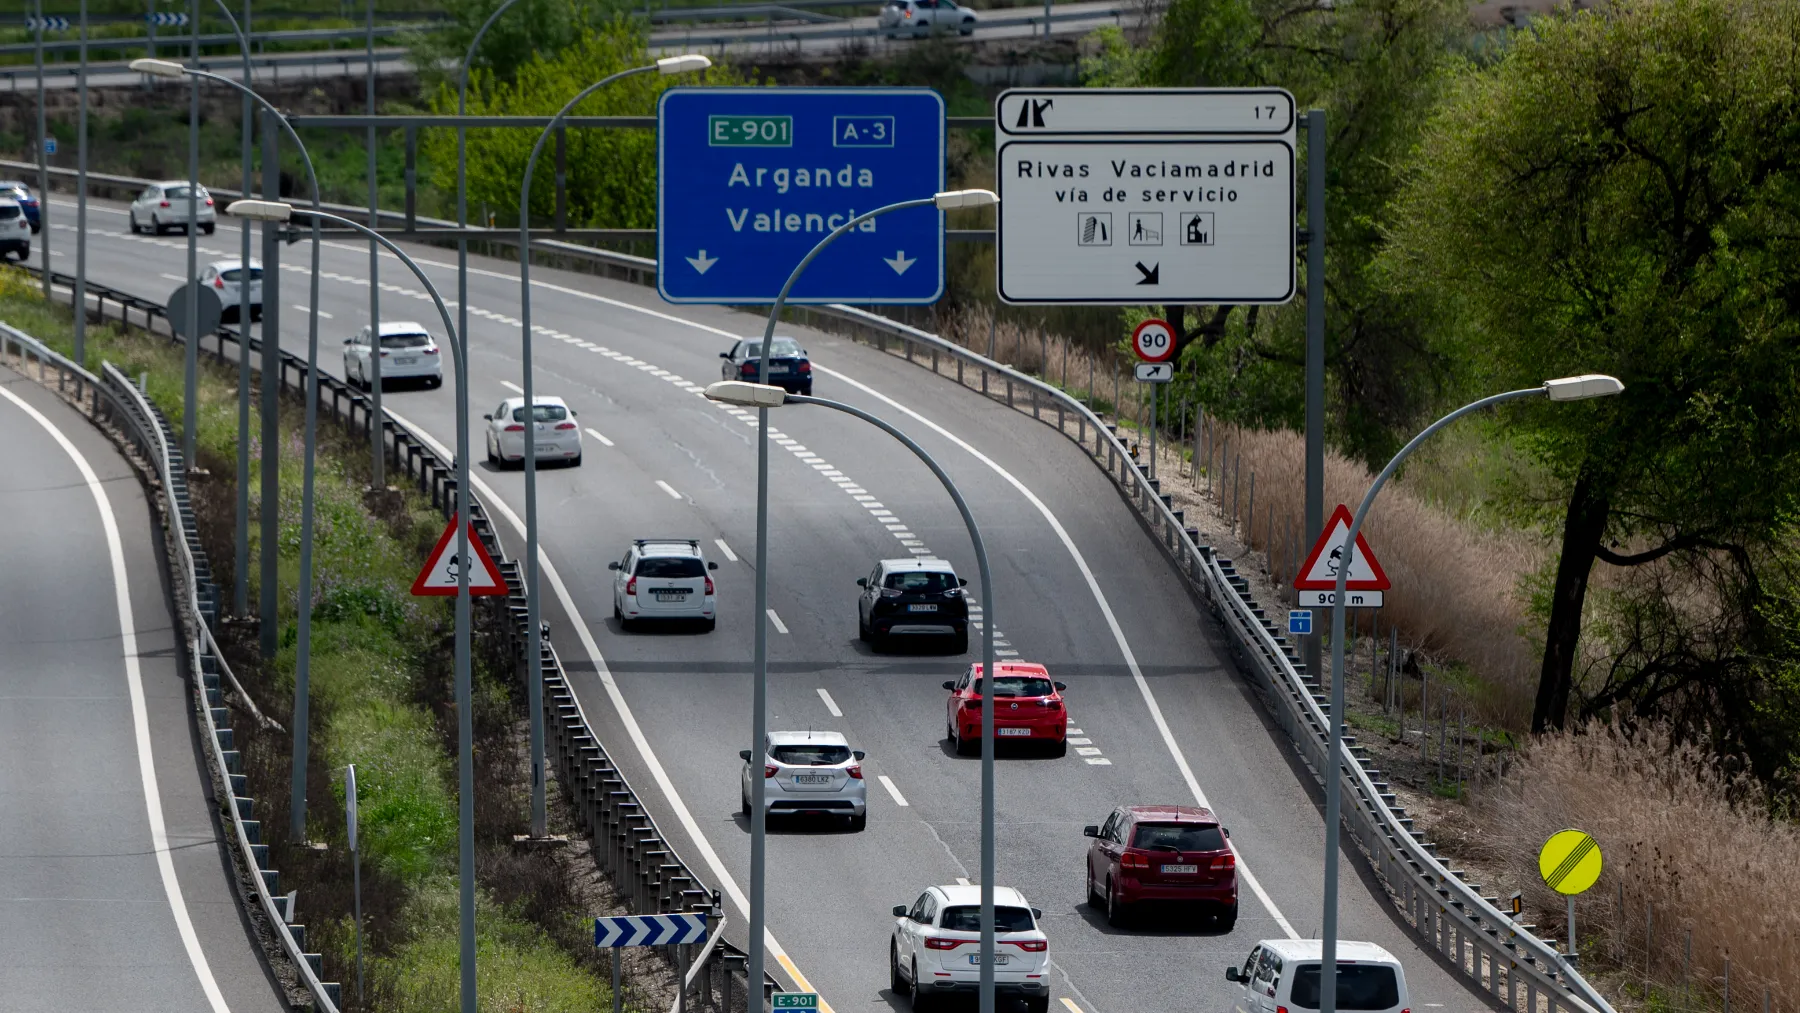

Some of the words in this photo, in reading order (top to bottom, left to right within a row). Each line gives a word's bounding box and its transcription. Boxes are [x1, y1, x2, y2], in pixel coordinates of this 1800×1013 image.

[1254, 106, 1276, 120] 17
[714, 121, 787, 141] E-901
[843, 123, 886, 140] A-3
[1018, 160, 1090, 178] Rivas
[1111, 160, 1274, 178] Vaciamadrid
[728, 163, 873, 194] Arganda
[1056, 187, 1088, 202] vía
[1103, 187, 1127, 202] de
[1142, 187, 1238, 202] servicio
[726, 208, 877, 233] Valencia
[1142, 333, 1166, 348] 90
[1318, 593, 1346, 604] 90
[1351, 595, 1364, 605] m
[1298, 621, 1303, 630] 1
[1165, 865, 1182, 873] 5325
[777, 996, 812, 1006] E-901
